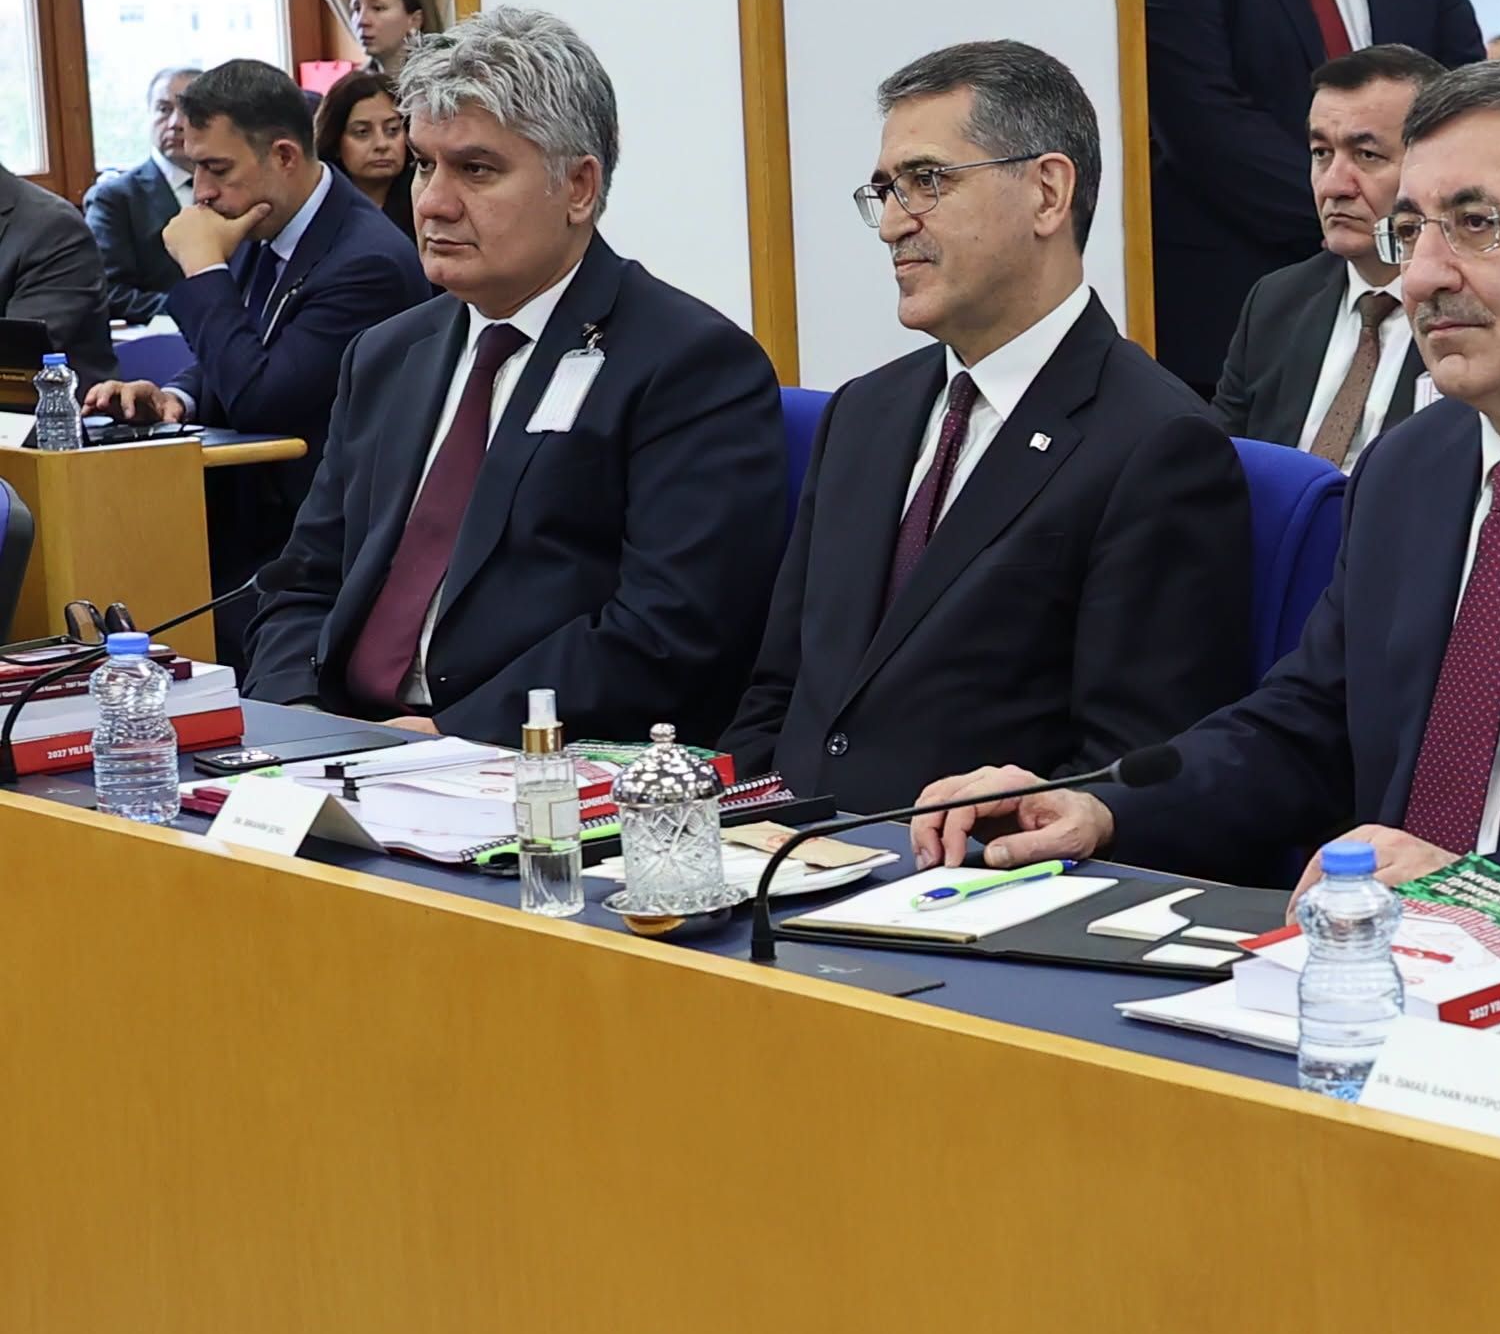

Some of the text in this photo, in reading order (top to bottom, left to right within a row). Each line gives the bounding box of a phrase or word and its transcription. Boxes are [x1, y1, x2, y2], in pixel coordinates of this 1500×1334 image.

[47, 749, 67, 759] 2027
[68, 746, 83, 756] YILI
[1469, 1007, 1489, 1021] 2027
